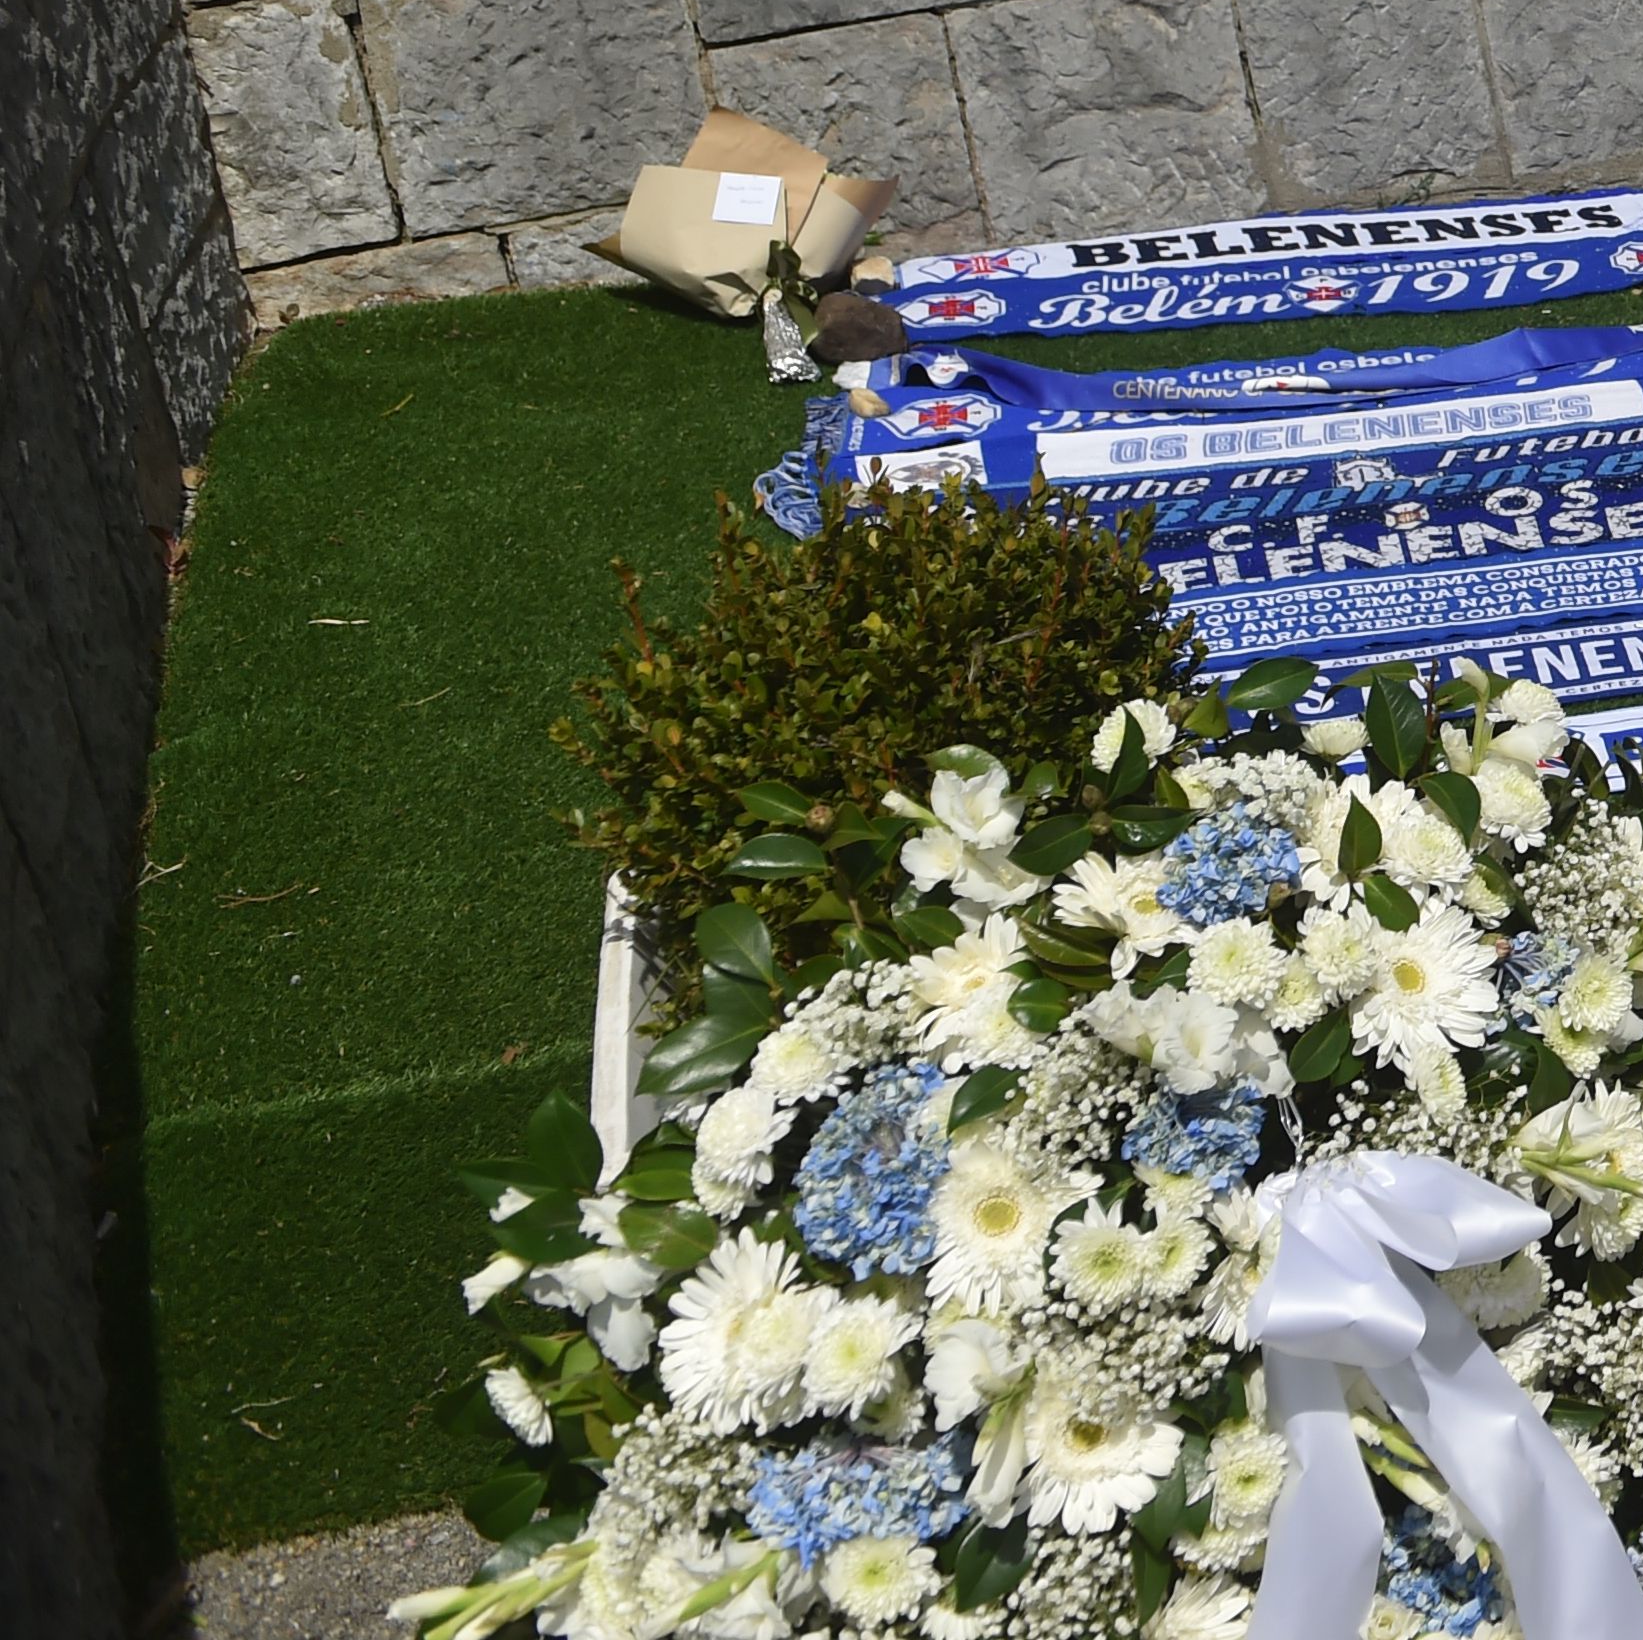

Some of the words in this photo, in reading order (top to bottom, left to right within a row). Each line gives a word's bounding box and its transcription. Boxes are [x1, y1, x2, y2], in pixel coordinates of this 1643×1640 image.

[1066, 204, 1623, 268] BELENENSES
[1028, 284, 1292, 329] Belém
[1368, 259, 1580, 305] 1919
[1082, 271, 1169, 294] clube
[1188, 361, 1306, 385] futebol
[1110, 434, 1188, 464] OS
[1204, 394, 1592, 459] BELENENSES
[1230, 467, 1309, 490] de
[1205, 611, 1261, 628] QUE
[1266, 605, 1313, 623] FOI
[1336, 592, 1415, 612] TEMA
[1419, 585, 1470, 601] DAS
[1472, 566, 1633, 595] CONQUISTAS
[1240, 601, 1448, 634] ANTIGAMENTE
[1460, 591, 1534, 610] NADA
[1541, 577, 1637, 597] TEMOS
[1256, 587, 1342, 607] NOSSO
[1348, 573, 1482, 596] EMBLEMA
[1240, 628, 1312, 648] PARA
[1316, 624, 1334, 637] A
[1339, 613, 1444, 634] FRENTE
[1449, 606, 1513, 623] COM
[1517, 601, 1536, 613] A
[1332, 641, 1481, 667] ANTIGAMENTE
[1492, 633, 1544, 646] NADA
[1559, 625, 1622, 638] TEMOS
